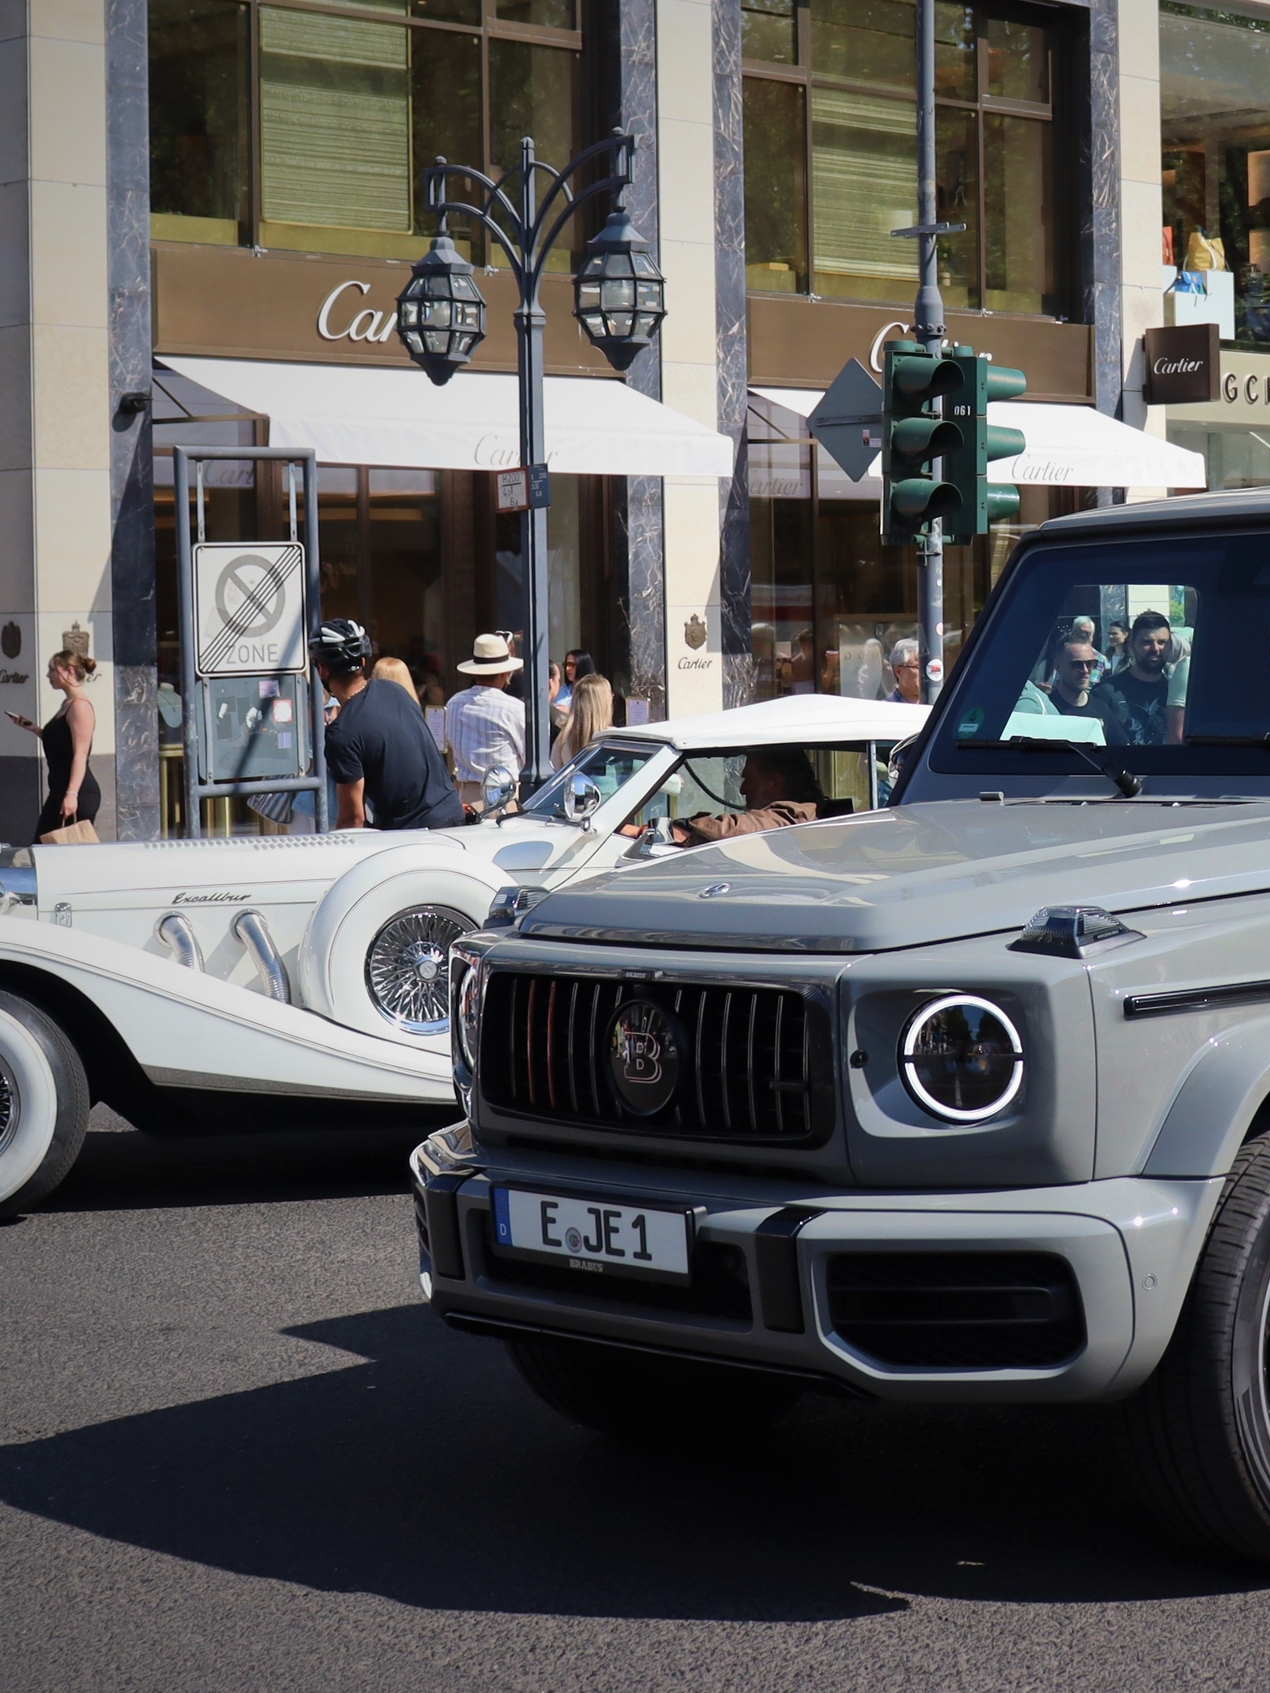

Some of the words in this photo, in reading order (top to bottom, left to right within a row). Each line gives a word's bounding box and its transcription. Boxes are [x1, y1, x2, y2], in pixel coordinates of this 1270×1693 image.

[1153, 356, 1204, 375] Cartier
[954, 405, 971, 416] 061
[1011, 453, 1074, 481] Cartier
[225, 643, 279, 664] ZONE
[678, 656, 713, 670] Cartier
[171, 892, 252, 905] Excalibur
[499, 1223, 507, 1236] D
[540, 1200, 562, 1248] E
[569, 1258, 604, 1273] BRABUS
